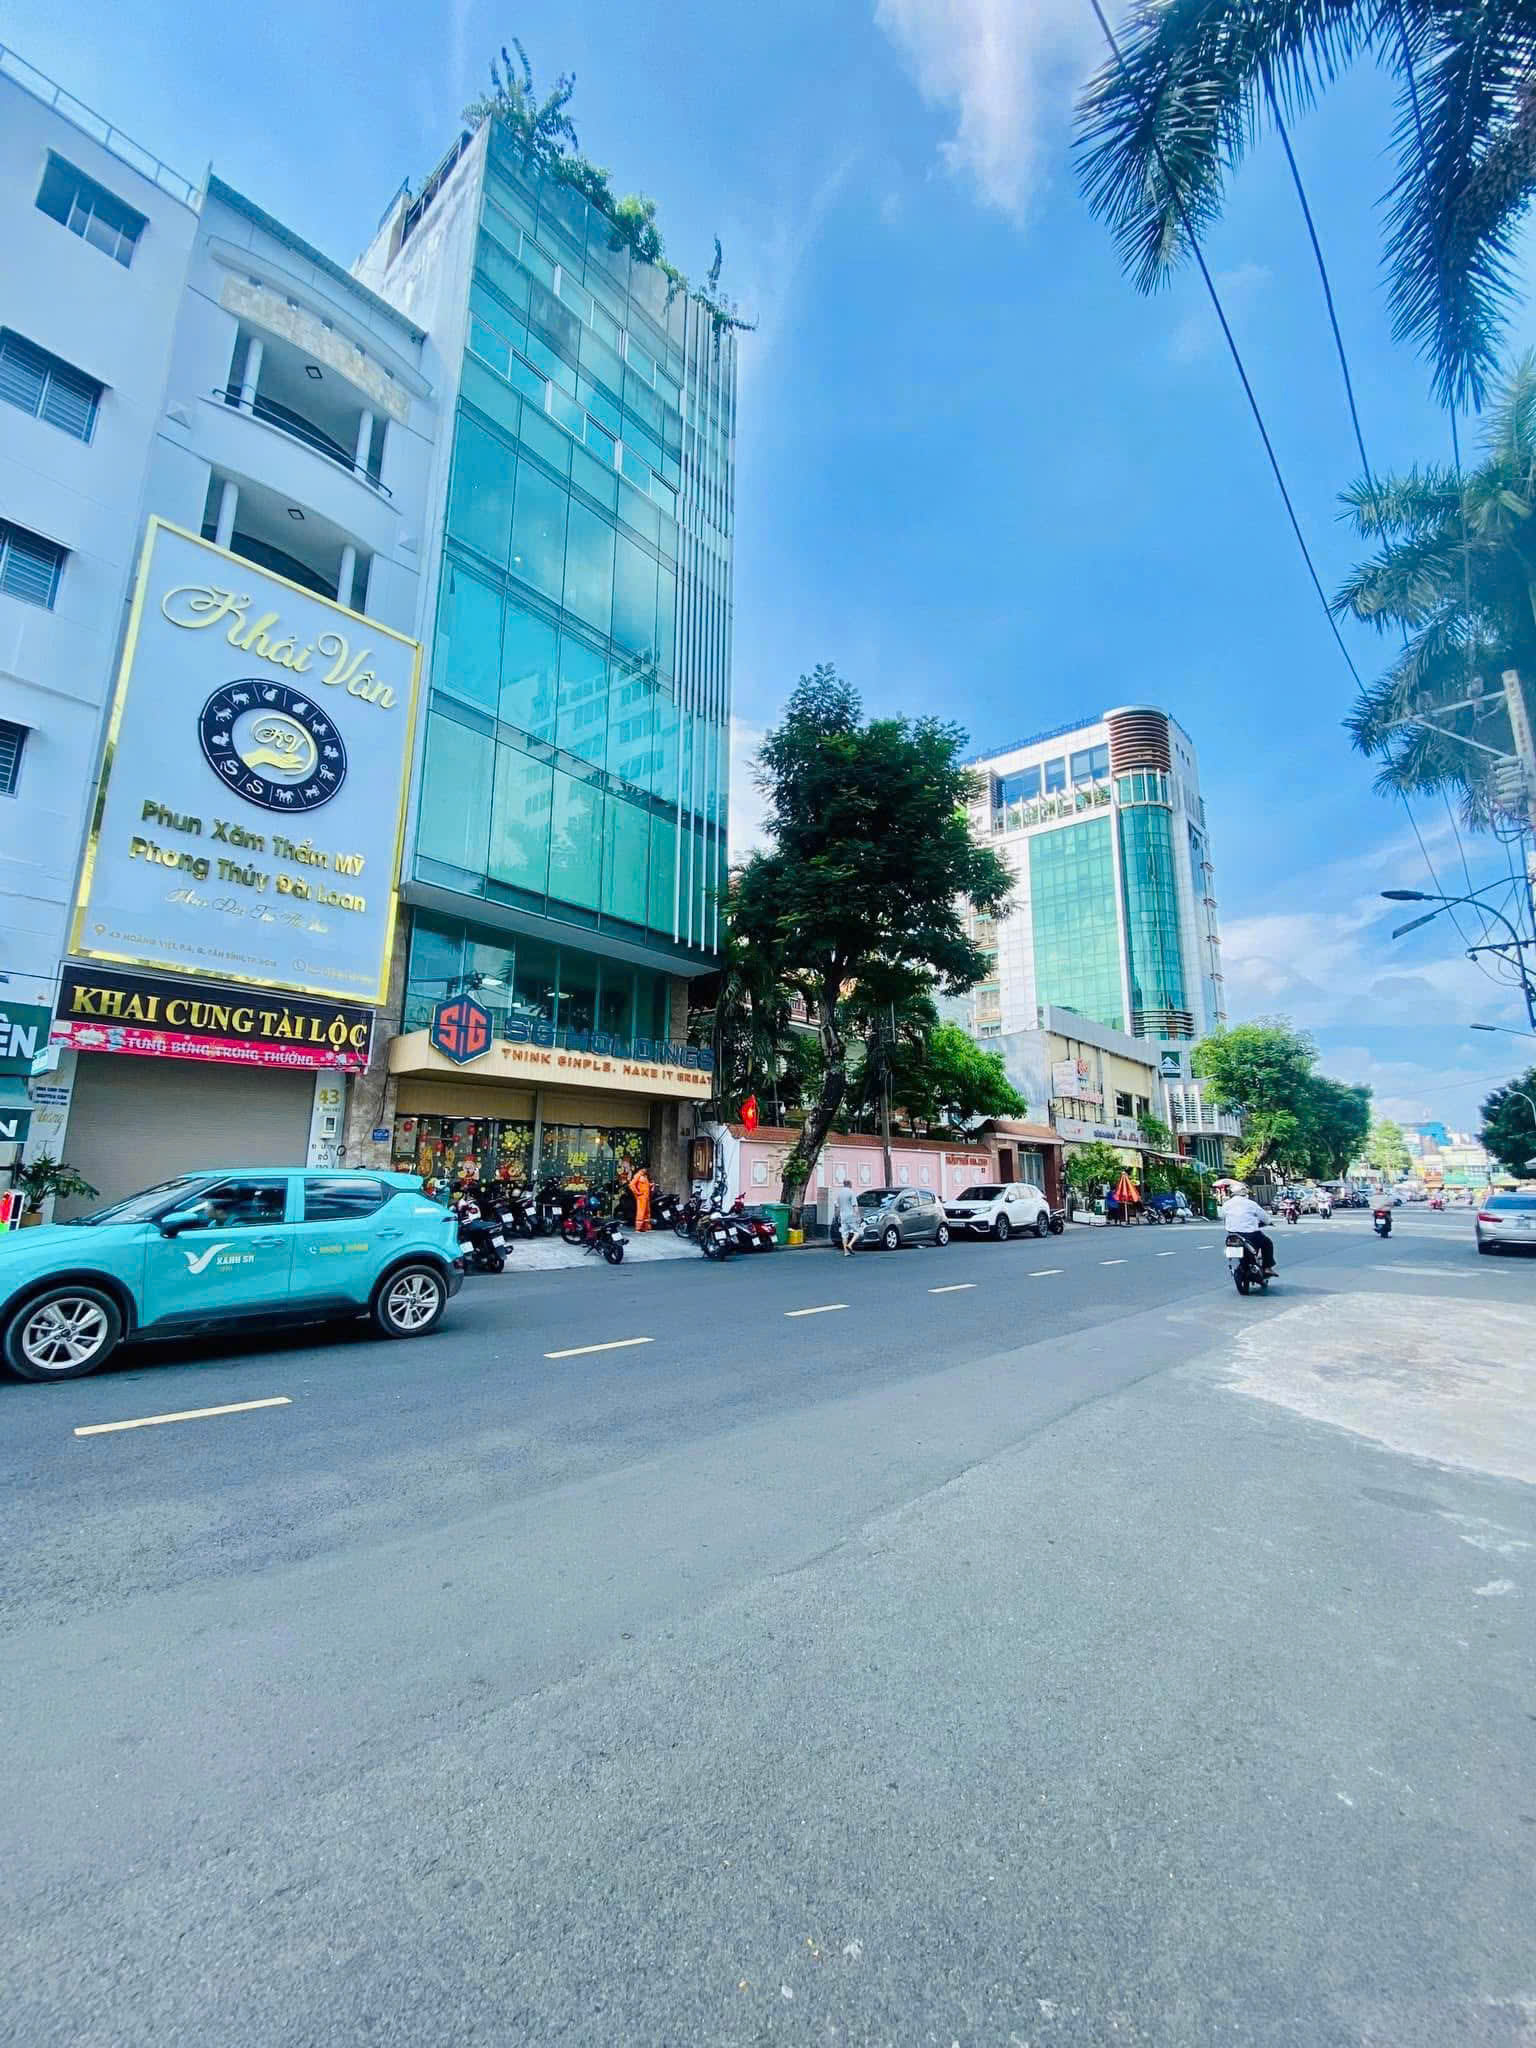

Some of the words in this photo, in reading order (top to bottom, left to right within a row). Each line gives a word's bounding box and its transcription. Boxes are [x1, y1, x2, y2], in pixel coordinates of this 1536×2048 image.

[318, 632, 398, 709] Vân
[141, 799, 203, 836] Phun
[210, 817, 265, 853] Xăm
[128, 836, 211, 880] Phong
[315, 883, 367, 914] Loan
[69, 985, 160, 1023] KHAI
[165, 999, 255, 1033] CUNG
[259, 1008, 305, 1040] TÀI
[309, 1014, 368, 1053] LỘC
[502, 1048, 551, 1065] THINK
[662, 1070, 673, 1080] IT
[320, 1088, 340, 1104] 43
